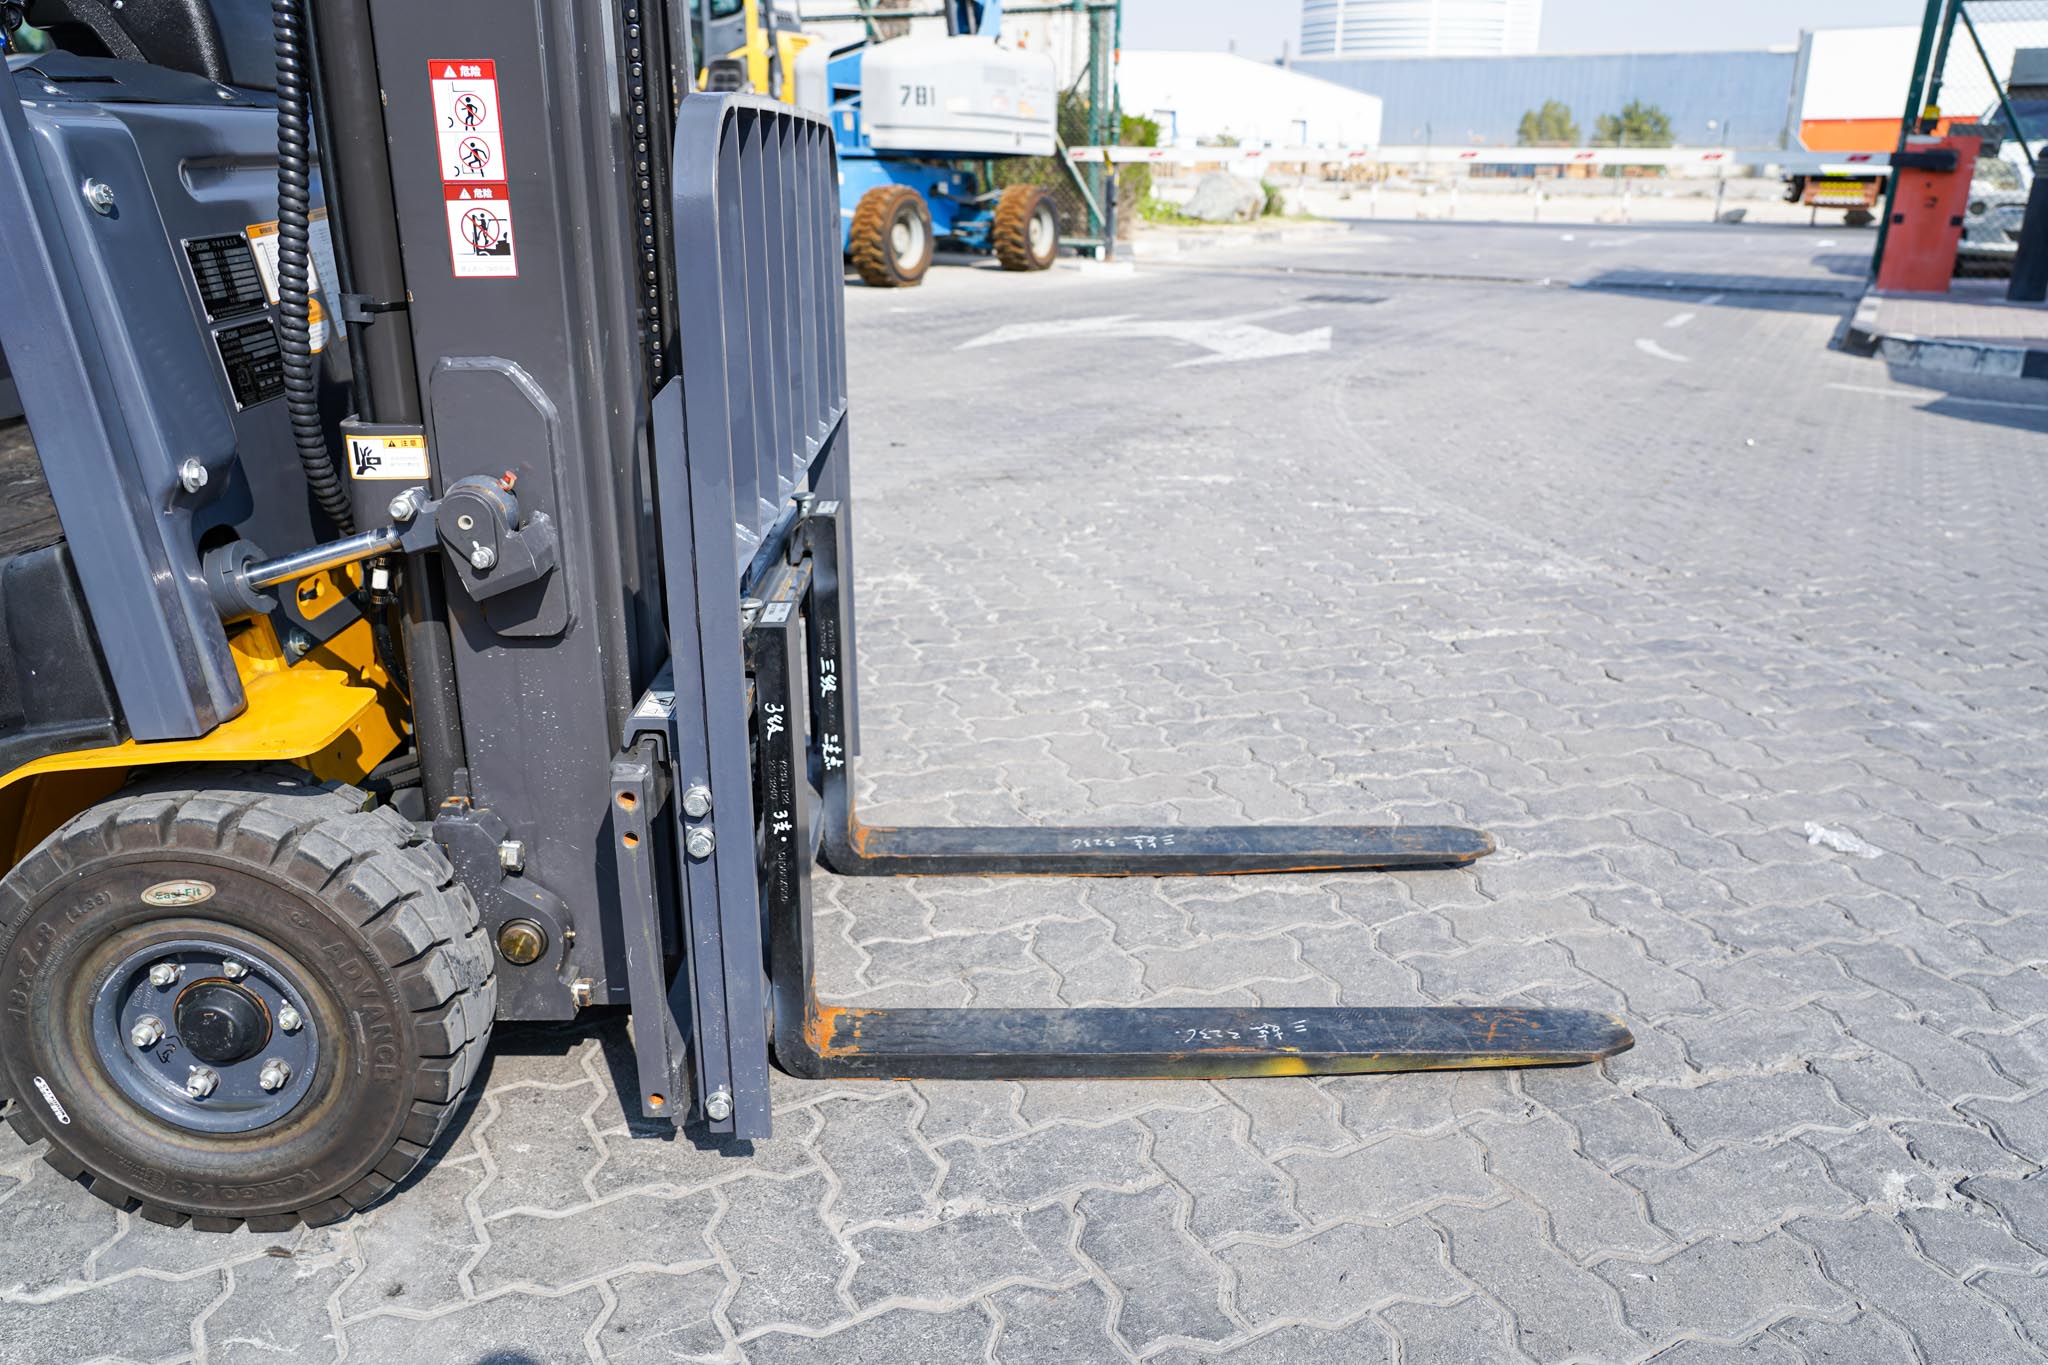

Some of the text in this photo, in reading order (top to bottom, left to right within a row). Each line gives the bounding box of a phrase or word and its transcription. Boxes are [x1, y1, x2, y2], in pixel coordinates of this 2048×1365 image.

[460, 65, 482, 77] 危险
[900, 85, 936, 106] 781
[473, 188, 493, 199] 危险
